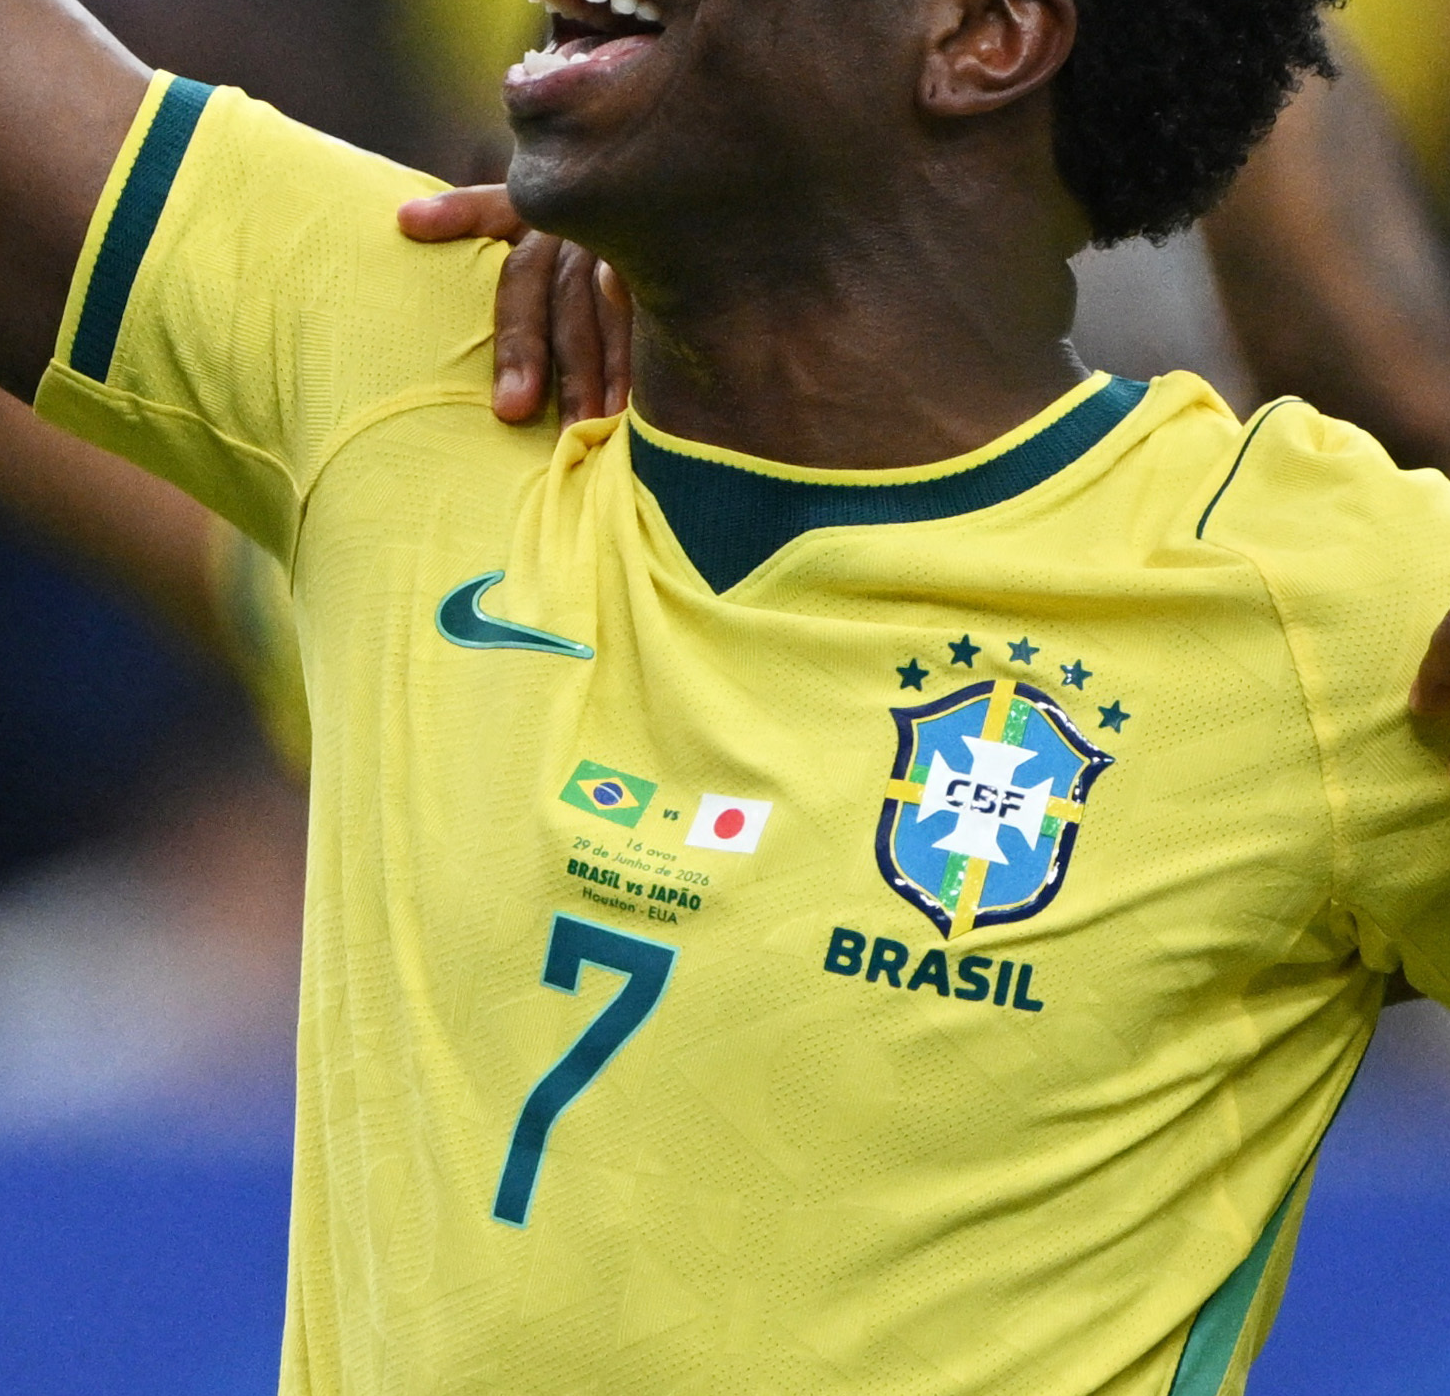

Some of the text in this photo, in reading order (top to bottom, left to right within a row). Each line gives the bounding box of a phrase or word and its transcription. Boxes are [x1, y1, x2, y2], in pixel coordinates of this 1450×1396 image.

[663, 808, 681, 821] vs
[945, 779, 1025, 818] CBF
[572, 836, 591, 851] 29
[592, 845, 609, 858] de
[655, 865, 671, 877] de
[675, 869, 710, 886] 2026
[626, 838, 644, 852] 16
[582, 886, 636, 913] Houston
[648, 905, 678, 925] EUA
[626, 881, 644, 896] vs
[647, 884, 702, 911] JAPÃO
[823, 927, 1044, 1012] BRASIL
[490, 910, 681, 1230] 7
